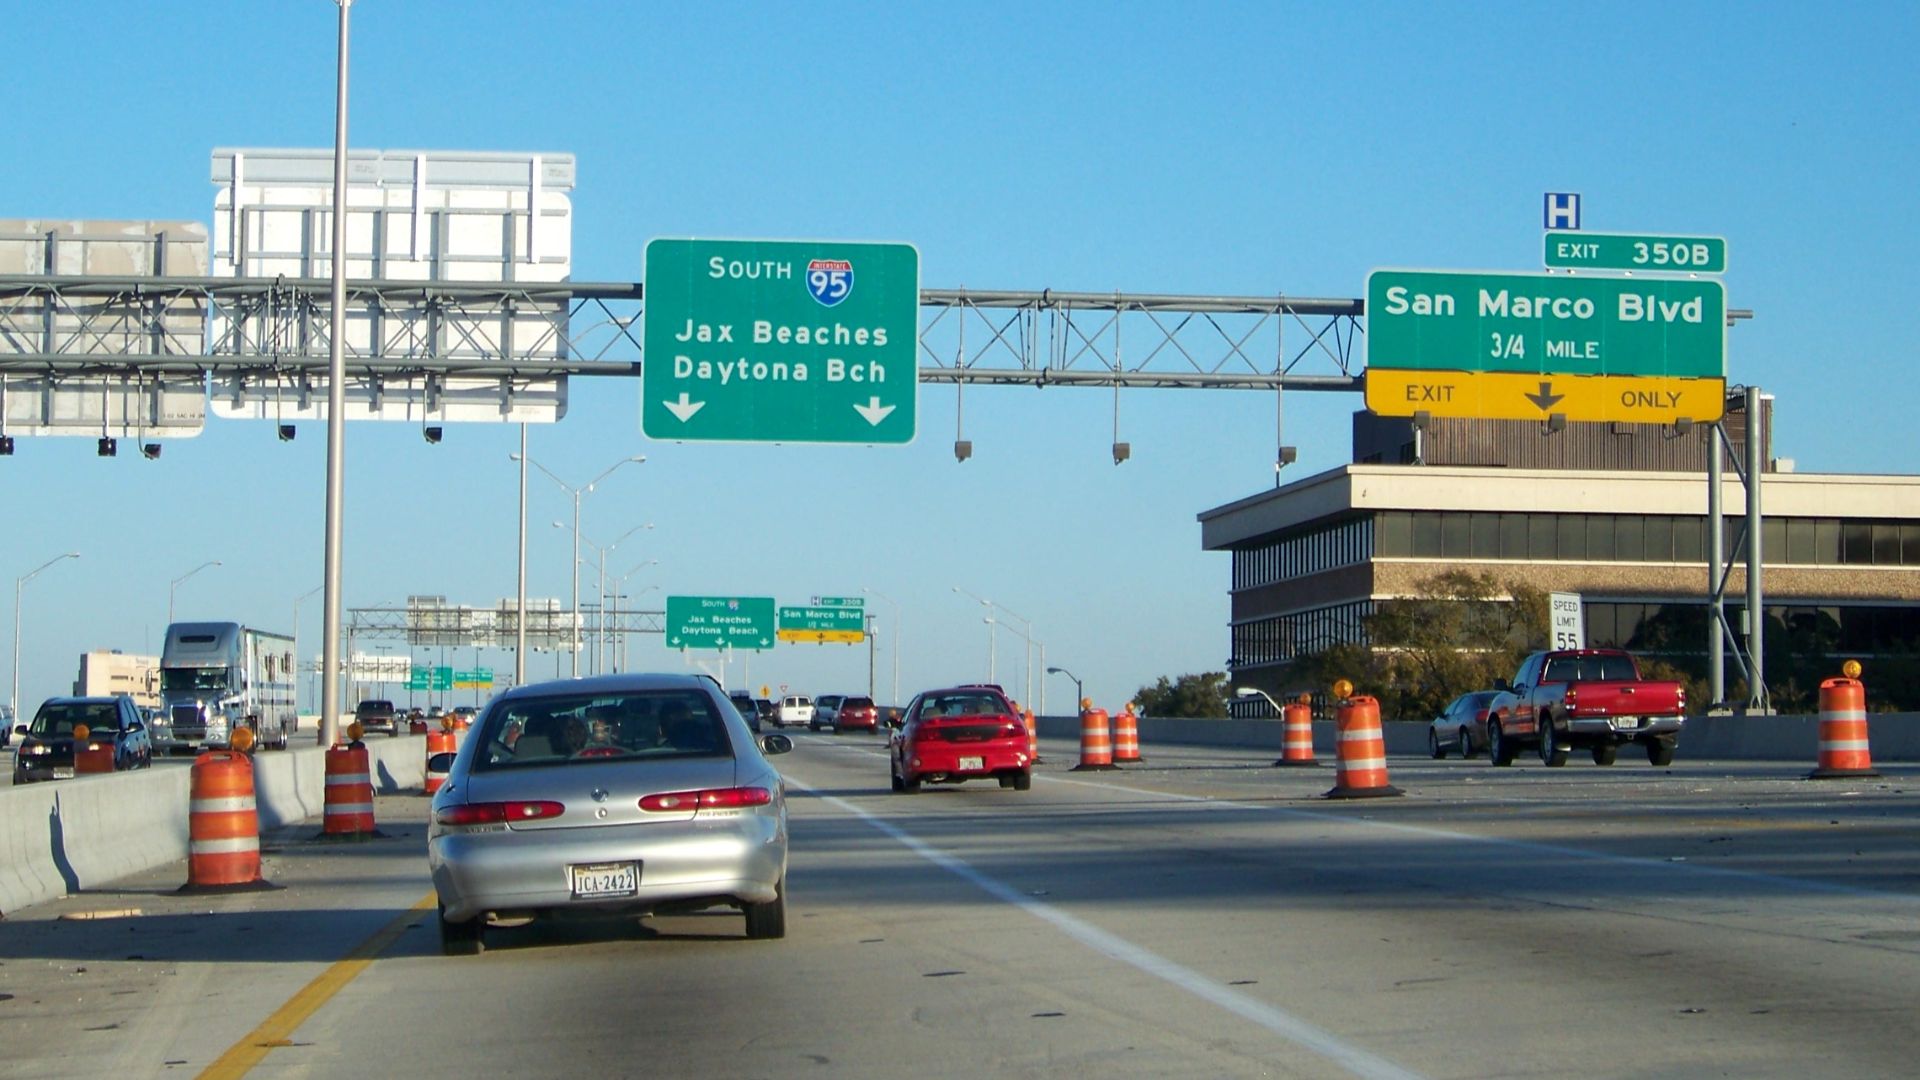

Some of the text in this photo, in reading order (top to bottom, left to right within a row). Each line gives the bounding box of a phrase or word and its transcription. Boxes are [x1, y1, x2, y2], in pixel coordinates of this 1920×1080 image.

[1549, 194, 1576, 229] H
[1558, 243, 1710, 265] EXIT 350B
[709, 256, 791, 279] SOUTH
[813, 262, 846, 270] INTERSTATE
[810, 271, 848, 298] 95
[1385, 286, 1703, 323] San Marco Blvd
[675, 319, 888, 346] Jax Beaches
[1490, 333, 1599, 359] 3/4 MILE
[674, 356, 885, 385] Daytona Bch
[1406, 385, 1682, 408] EXIT ONLY
[783, 610, 861, 619] San Marco Blvd
[1553, 600, 1578, 612] SPEED
[682, 626, 758, 635] Daytona Beach
[712, 616, 752, 624] Beaches
[1556, 617, 1576, 628] LIMIT
[1557, 632, 1578, 650] 55
